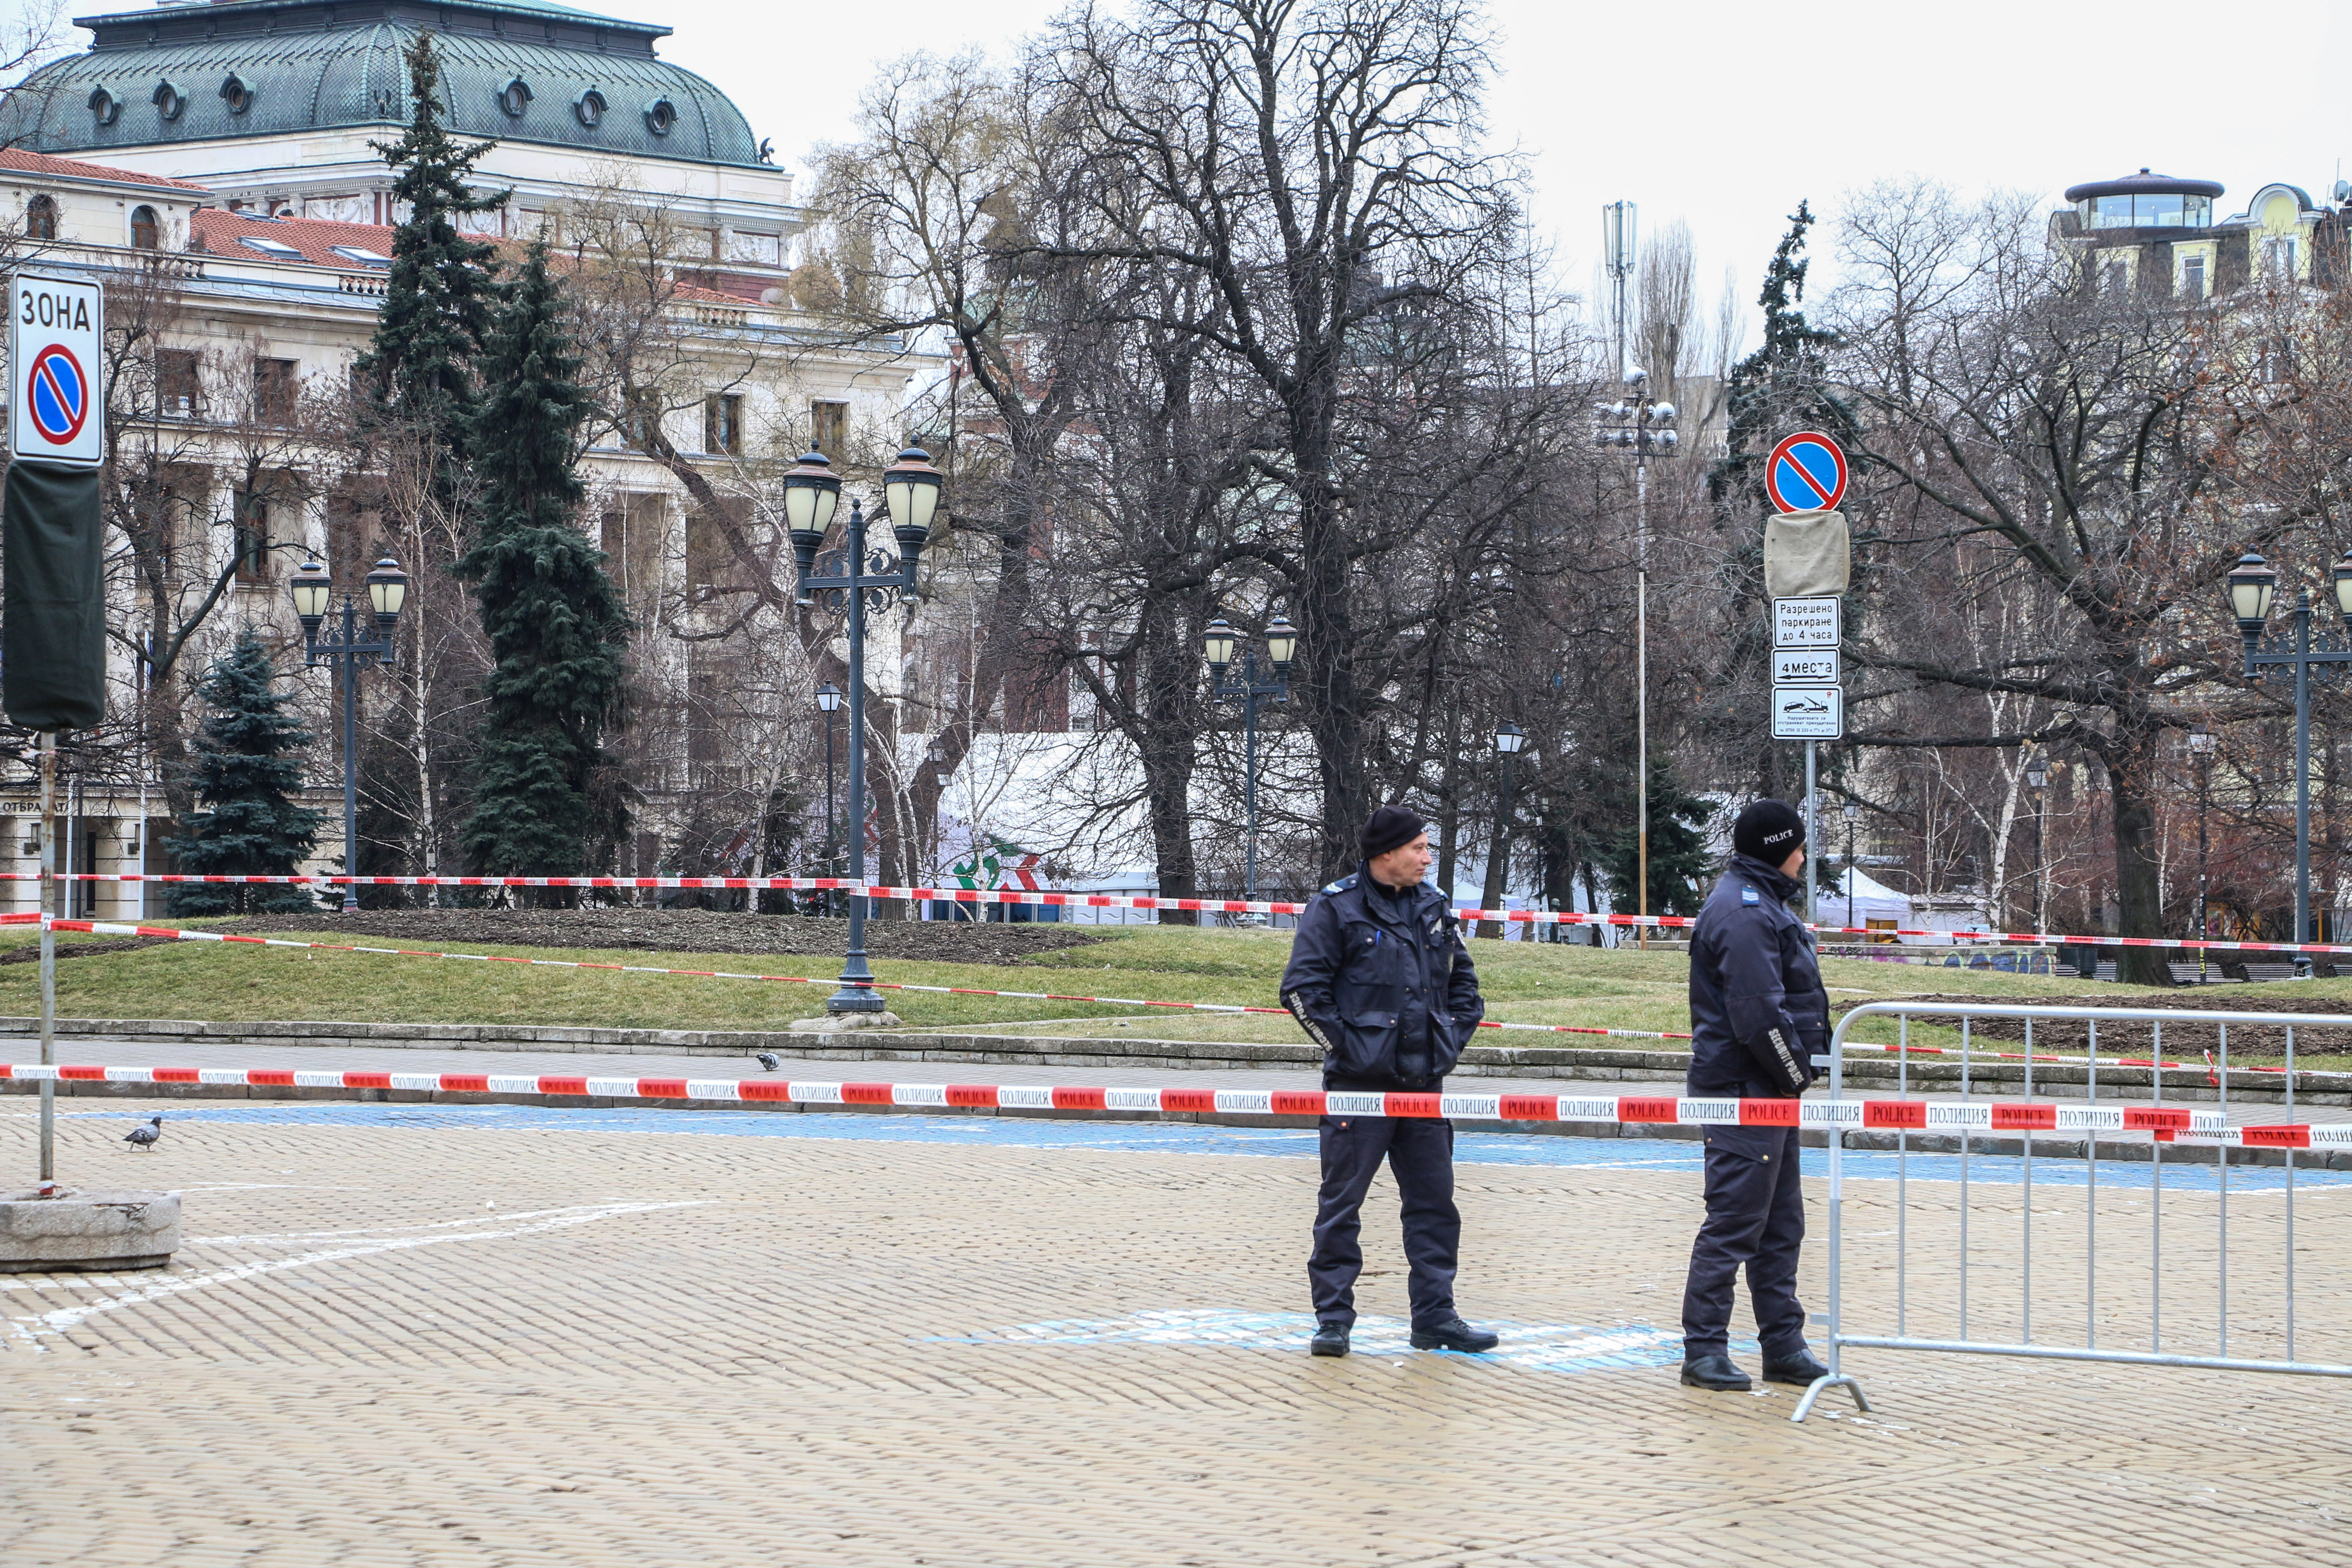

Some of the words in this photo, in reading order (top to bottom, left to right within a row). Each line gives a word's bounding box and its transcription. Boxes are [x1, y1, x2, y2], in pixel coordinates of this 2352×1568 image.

[21, 290, 91, 332] ЗОНА
[1780, 604, 1832, 616] Разрешено
[1782, 619, 1832, 629] паркиране
[1782, 632, 1793, 641] до
[1799, 630, 1805, 640] 4
[1763, 829, 1794, 845] POLICE
[1289, 991, 1308, 1020] POLICE
[1302, 1019, 1333, 1052] SECURITY
[1768, 1028, 1793, 1063] SECURITY
[1785, 1060, 1805, 1086] POLICE
[588, 1081, 635, 1096] ПОЛИЦИЯ
[689, 1084, 735, 1099] ПОЛИЦИЯ
[791, 1086, 839, 1101] ПОЛИЦИЯ
[848, 1087, 883, 1102] POLICE
[895, 1088, 943, 1103] ПОЛИЦИЯ
[953, 1089, 989, 1103] POLICE
[1000, 1090, 1049, 1106] ПОЛИЦИЯ
[1060, 1092, 1096, 1106] POLICE
[1108, 1092, 1158, 1109] ПОЛИЦИЯ
[1168, 1093, 1206, 1109] POLICE
[1217, 1094, 1268, 1111] ПОЛИЦИЯ
[1280, 1096, 1317, 1111] POLICE
[1329, 1096, 1381, 1113] ПОЛИЦИЯ
[1392, 1098, 1431, 1113] POLICE
[1442, 1099, 1497, 1117] ПОЛИЦИЯ
[1508, 1100, 1548, 1116] POLICE
[1560, 1101, 1615, 1118] ПОЛИЦИЯ
[1626, 1102, 1667, 1118] POLICE
[1680, 1102, 1736, 1120] ПОЛИЦИЯ
[1748, 1104, 1790, 1121] POLICE
[1803, 1105, 1860, 1124] ПОЛИЦИЯ
[1873, 1106, 1916, 1123] POLICE
[1929, 1108, 1989, 1127] ПОЛИЦИЯ
[2001, 1109, 2045, 1126] POLICE
[2059, 1110, 2120, 1128] ПОЛИЦИЯ
[2134, 1113, 2180, 1127] POLICE
[2314, 1130, 2352, 1142] ПОЛИ
